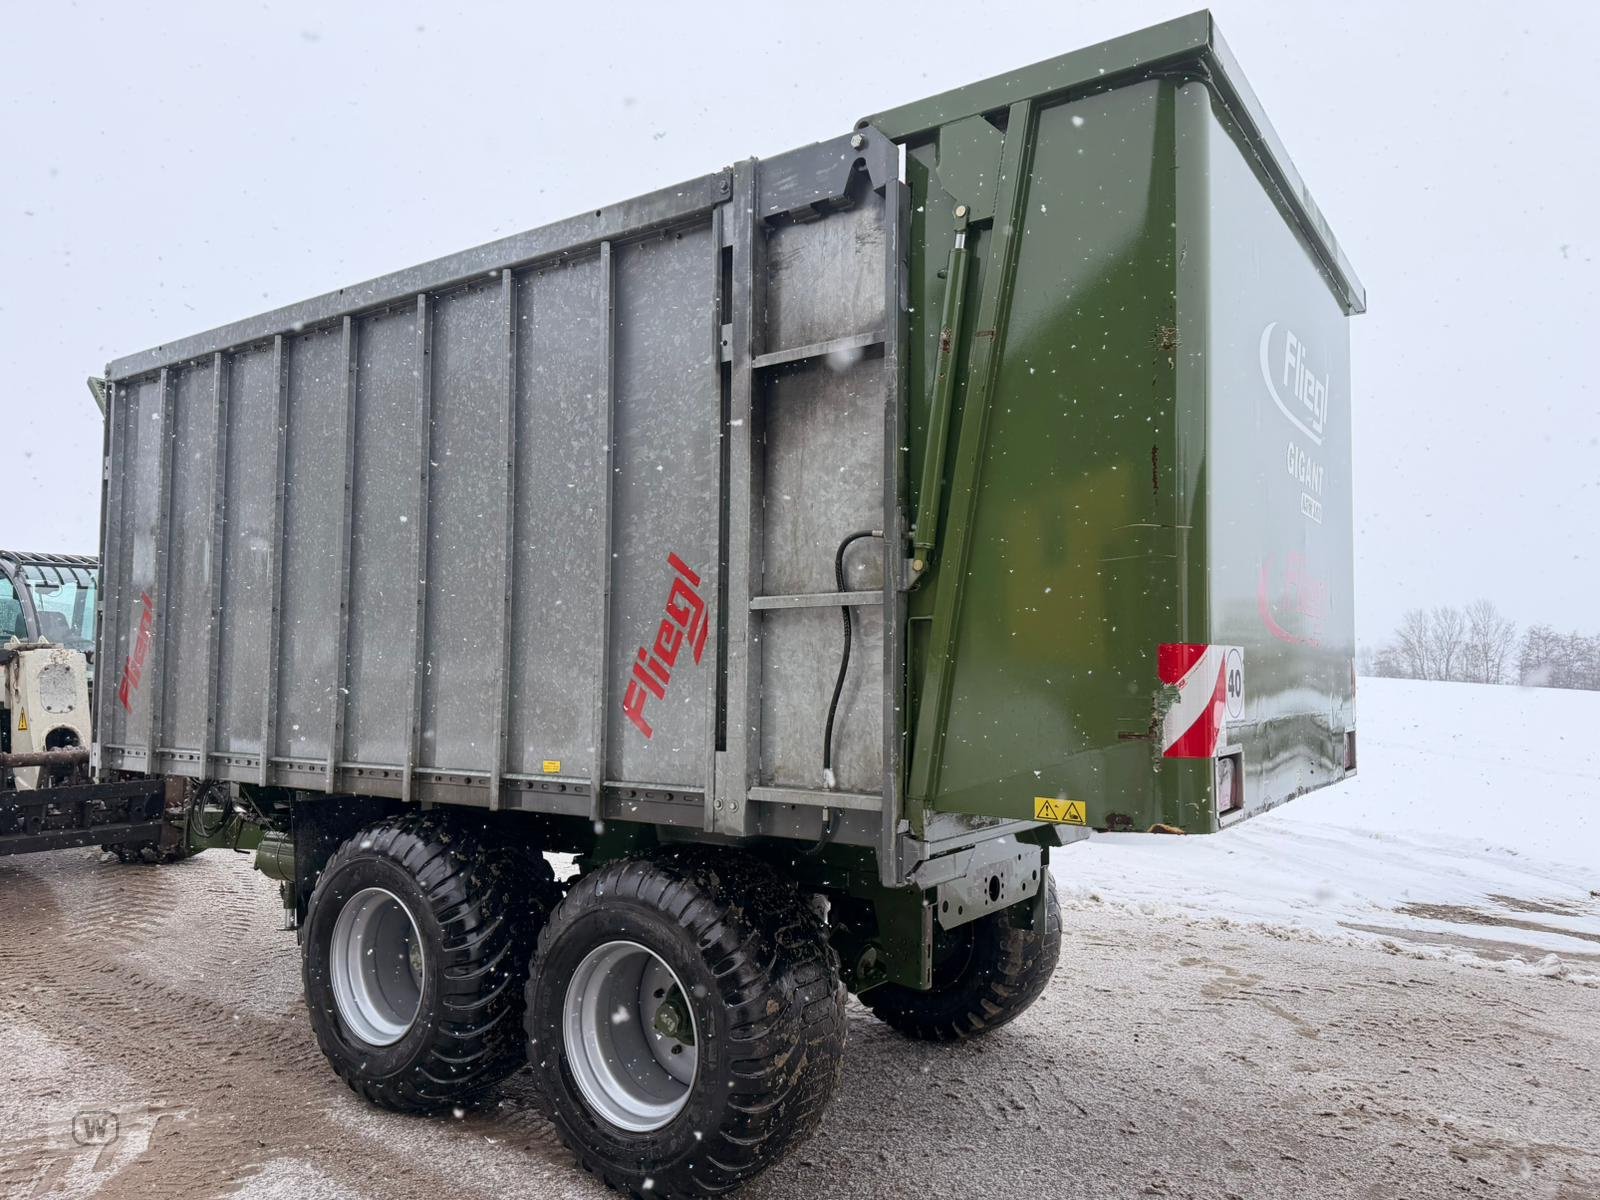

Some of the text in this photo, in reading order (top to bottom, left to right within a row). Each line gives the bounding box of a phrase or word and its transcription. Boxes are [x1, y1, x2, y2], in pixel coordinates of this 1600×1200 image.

[1283, 330, 1329, 434] Fliegl
[1287, 441, 1323, 496] GIGANT
[622, 551, 709, 740] Fliegl
[1228, 669, 1241, 698] 40
